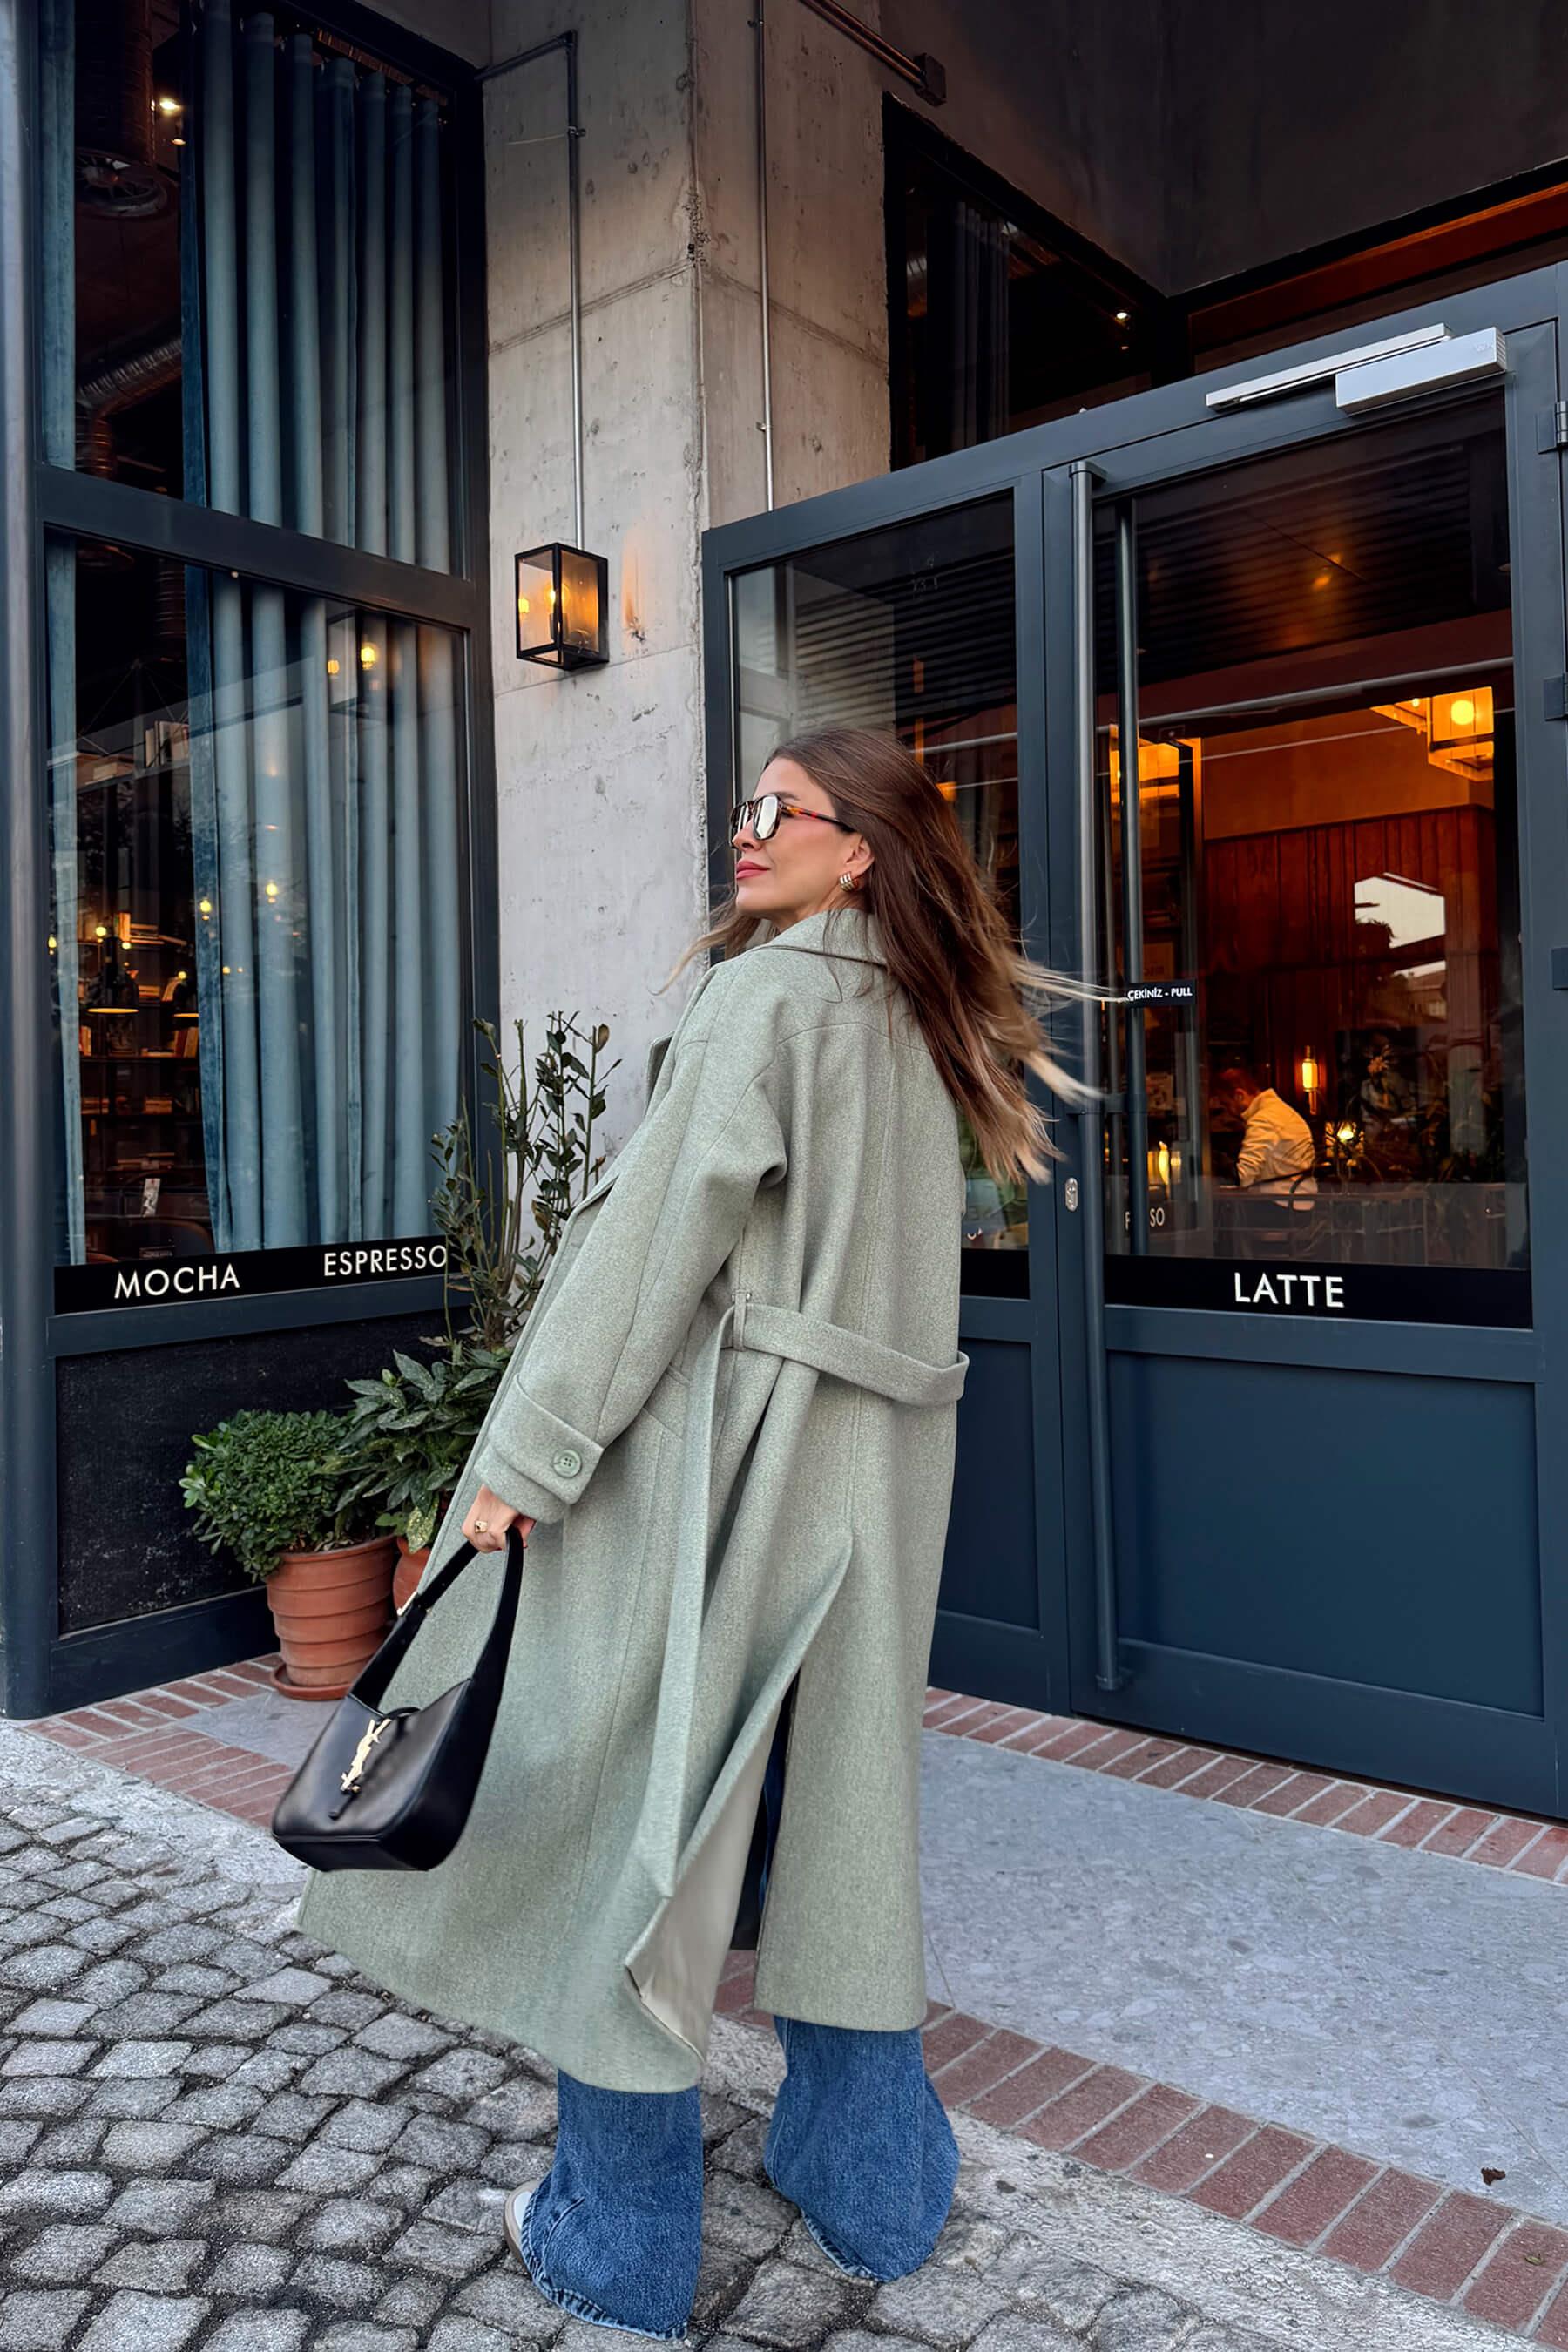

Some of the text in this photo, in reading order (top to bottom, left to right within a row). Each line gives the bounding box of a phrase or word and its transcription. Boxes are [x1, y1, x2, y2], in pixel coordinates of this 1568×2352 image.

[1171, 986, 1193, 997] PULL
[114, 1244, 447, 1299] MOCHA ESPRESSO
[1233, 1272, 1345, 1308] LATTE
